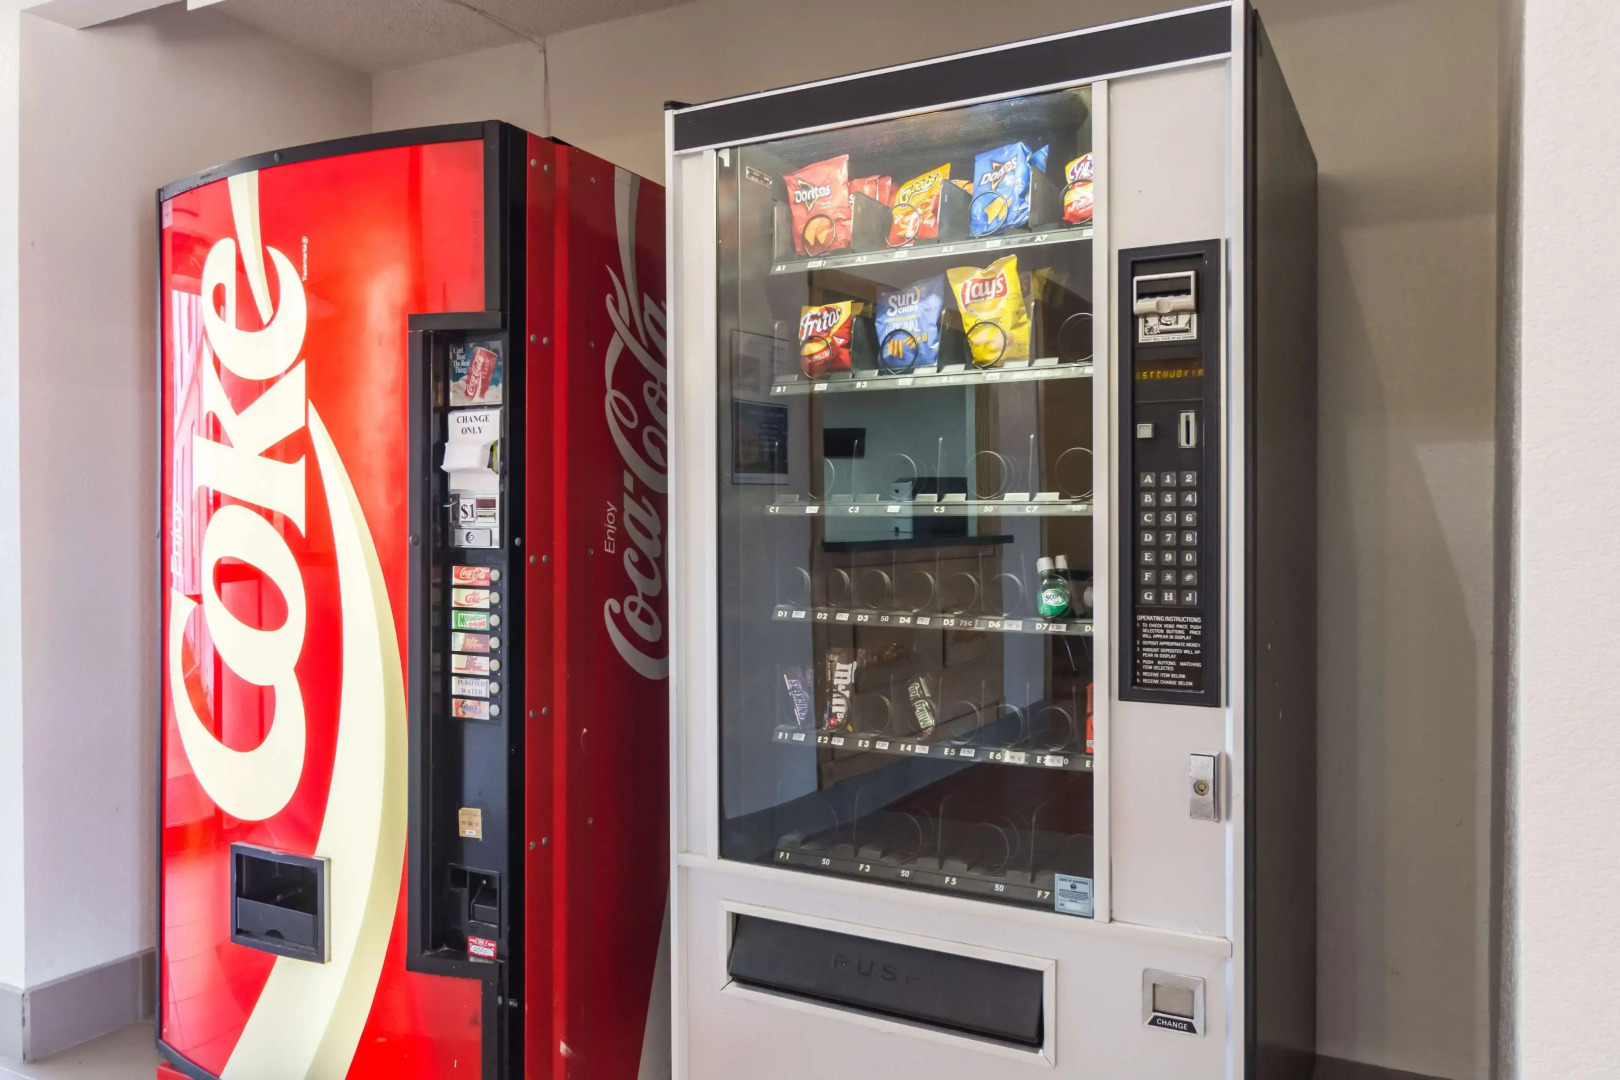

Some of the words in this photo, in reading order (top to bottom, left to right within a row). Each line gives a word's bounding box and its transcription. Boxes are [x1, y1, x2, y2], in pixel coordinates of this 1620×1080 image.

[794, 184, 831, 203] Doritos
[964, 274, 1005, 303] Lay's
[886, 286, 920, 317] Sun
[898, 304, 918, 313] CHIPS
[800, 308, 841, 340] Fritos
[456, 414, 490, 424] CHANGE
[461, 426, 482, 435] ONLY
[461, 504, 474, 519] $1
[171, 237, 308, 821] Coke
[604, 501, 616, 554] Enjoy
[1165, 534, 1172, 542] 7
[1145, 553, 1152, 561] E
[1145, 573, 1152, 581] F
[1144, 592, 1152, 600] G
[1164, 592, 1173, 601] H
[1186, 593, 1192, 601] J
[789, 679, 808, 721] SNICKERS
[900, 870, 910, 878] 50
[994, 884, 1005, 892] 50
[1156, 1018, 1188, 1031] CHANGE
